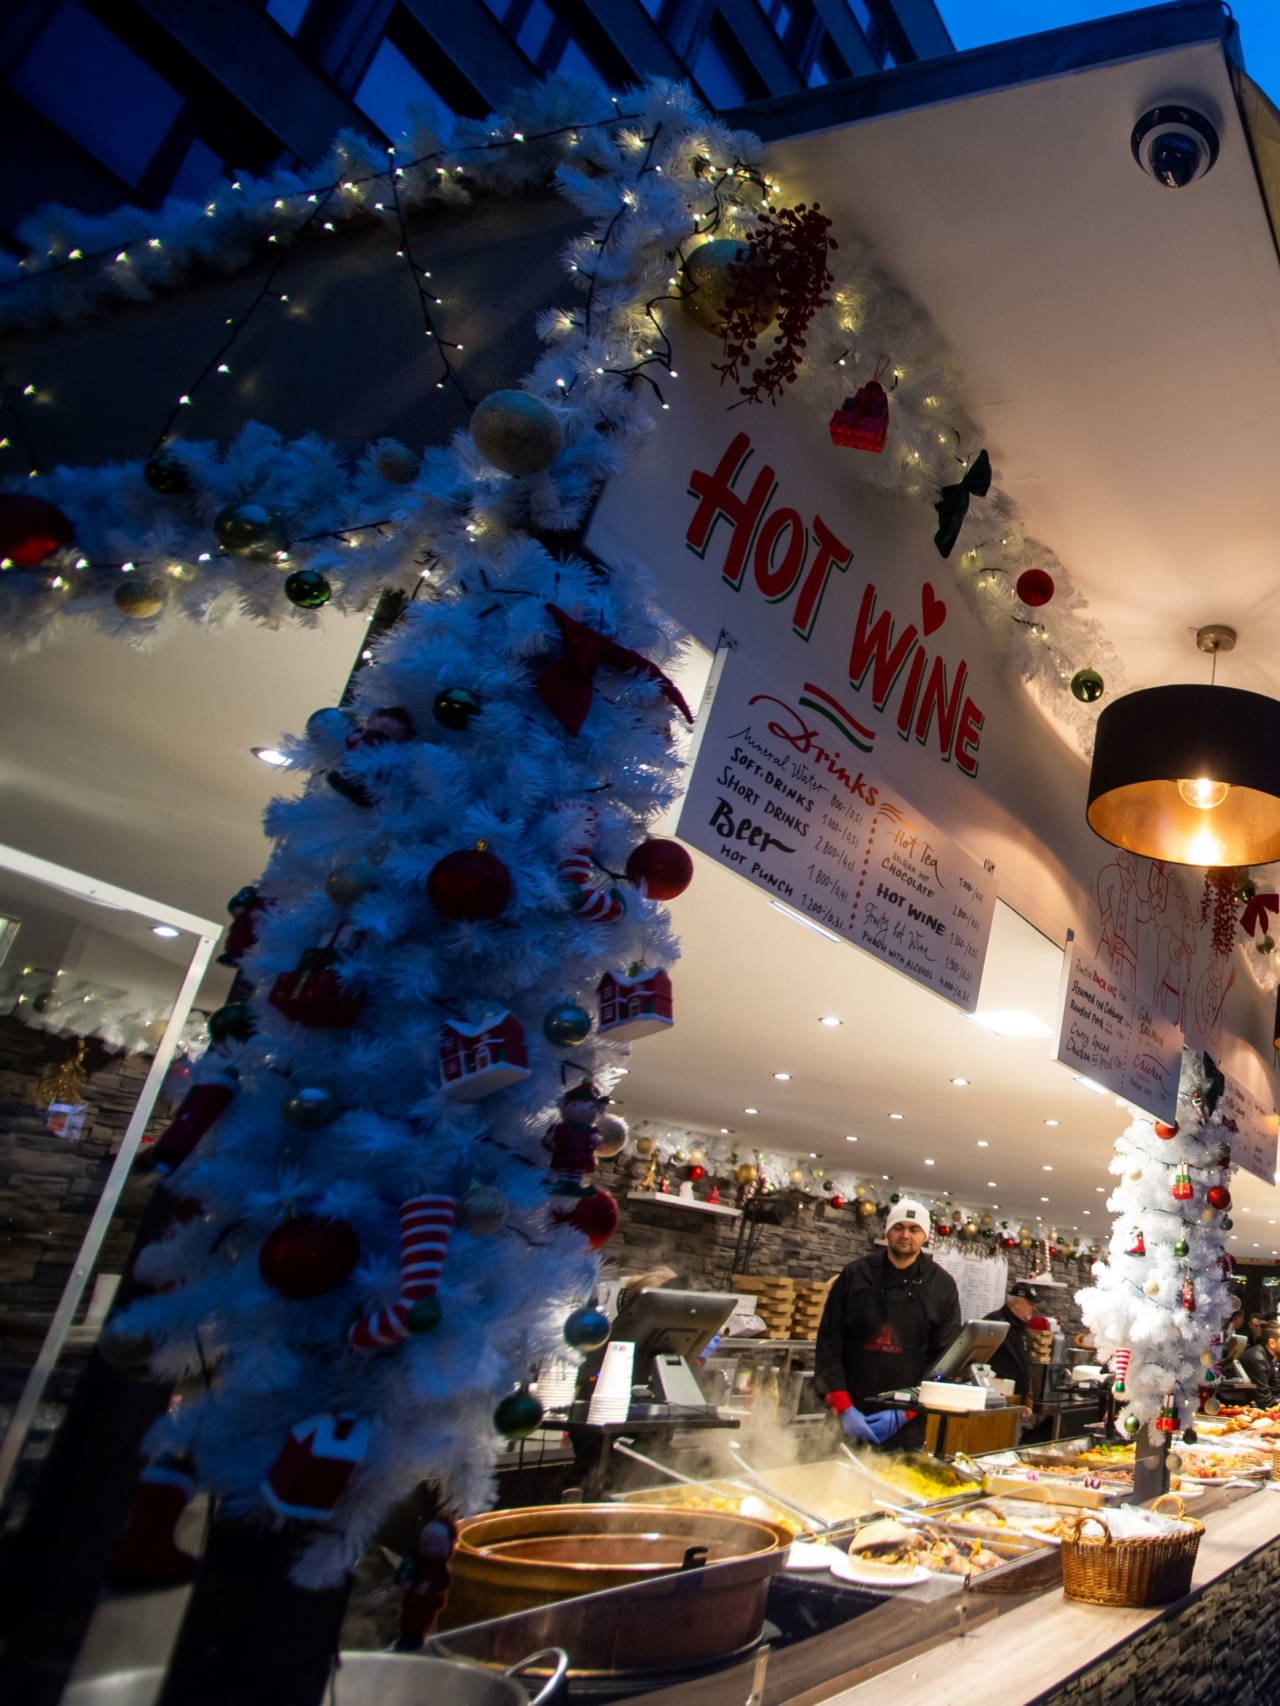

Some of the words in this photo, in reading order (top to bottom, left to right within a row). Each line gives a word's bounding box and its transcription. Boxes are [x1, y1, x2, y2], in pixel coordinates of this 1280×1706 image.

[686, 431, 854, 642] HOT
[848, 583, 985, 779] WINE
[727, 726, 790, 771] Mineral
[791, 761, 829, 794] Water
[748, 695, 878, 806] Drinks
[709, 796, 796, 854] Beer
[716, 765, 761, 806] SHORT
[764, 800, 810, 837] DRINKS
[720, 844, 747, 865] HOT
[751, 861, 794, 897] PUNCH
[881, 857, 935, 898] CHOCOLATE
[885, 830, 919, 860] Hot
[920, 842, 945, 888] Tea
[892, 851, 916, 874] BELGIAN
[918, 871, 930, 884] HOT
[863, 902, 889, 940] Fruity
[892, 920, 905, 945] hot
[909, 931, 937, 962] Wine
[876, 882, 907, 908] HOT
[907, 903, 947, 936] WINE
[888, 949, 905, 968] WITH
[905, 956, 934, 981] ALCOHOL
[1092, 970, 1107, 992] DUCK
[1107, 983, 1118, 1000] LEG
[1070, 999, 1092, 1021] Roasted
[1071, 980, 1096, 1005] Steamed
[1066, 1036, 1091, 1063] Chicken
[1071, 1021, 1090, 1048] Curry
[1091, 1034, 1110, 1054] Spiced
